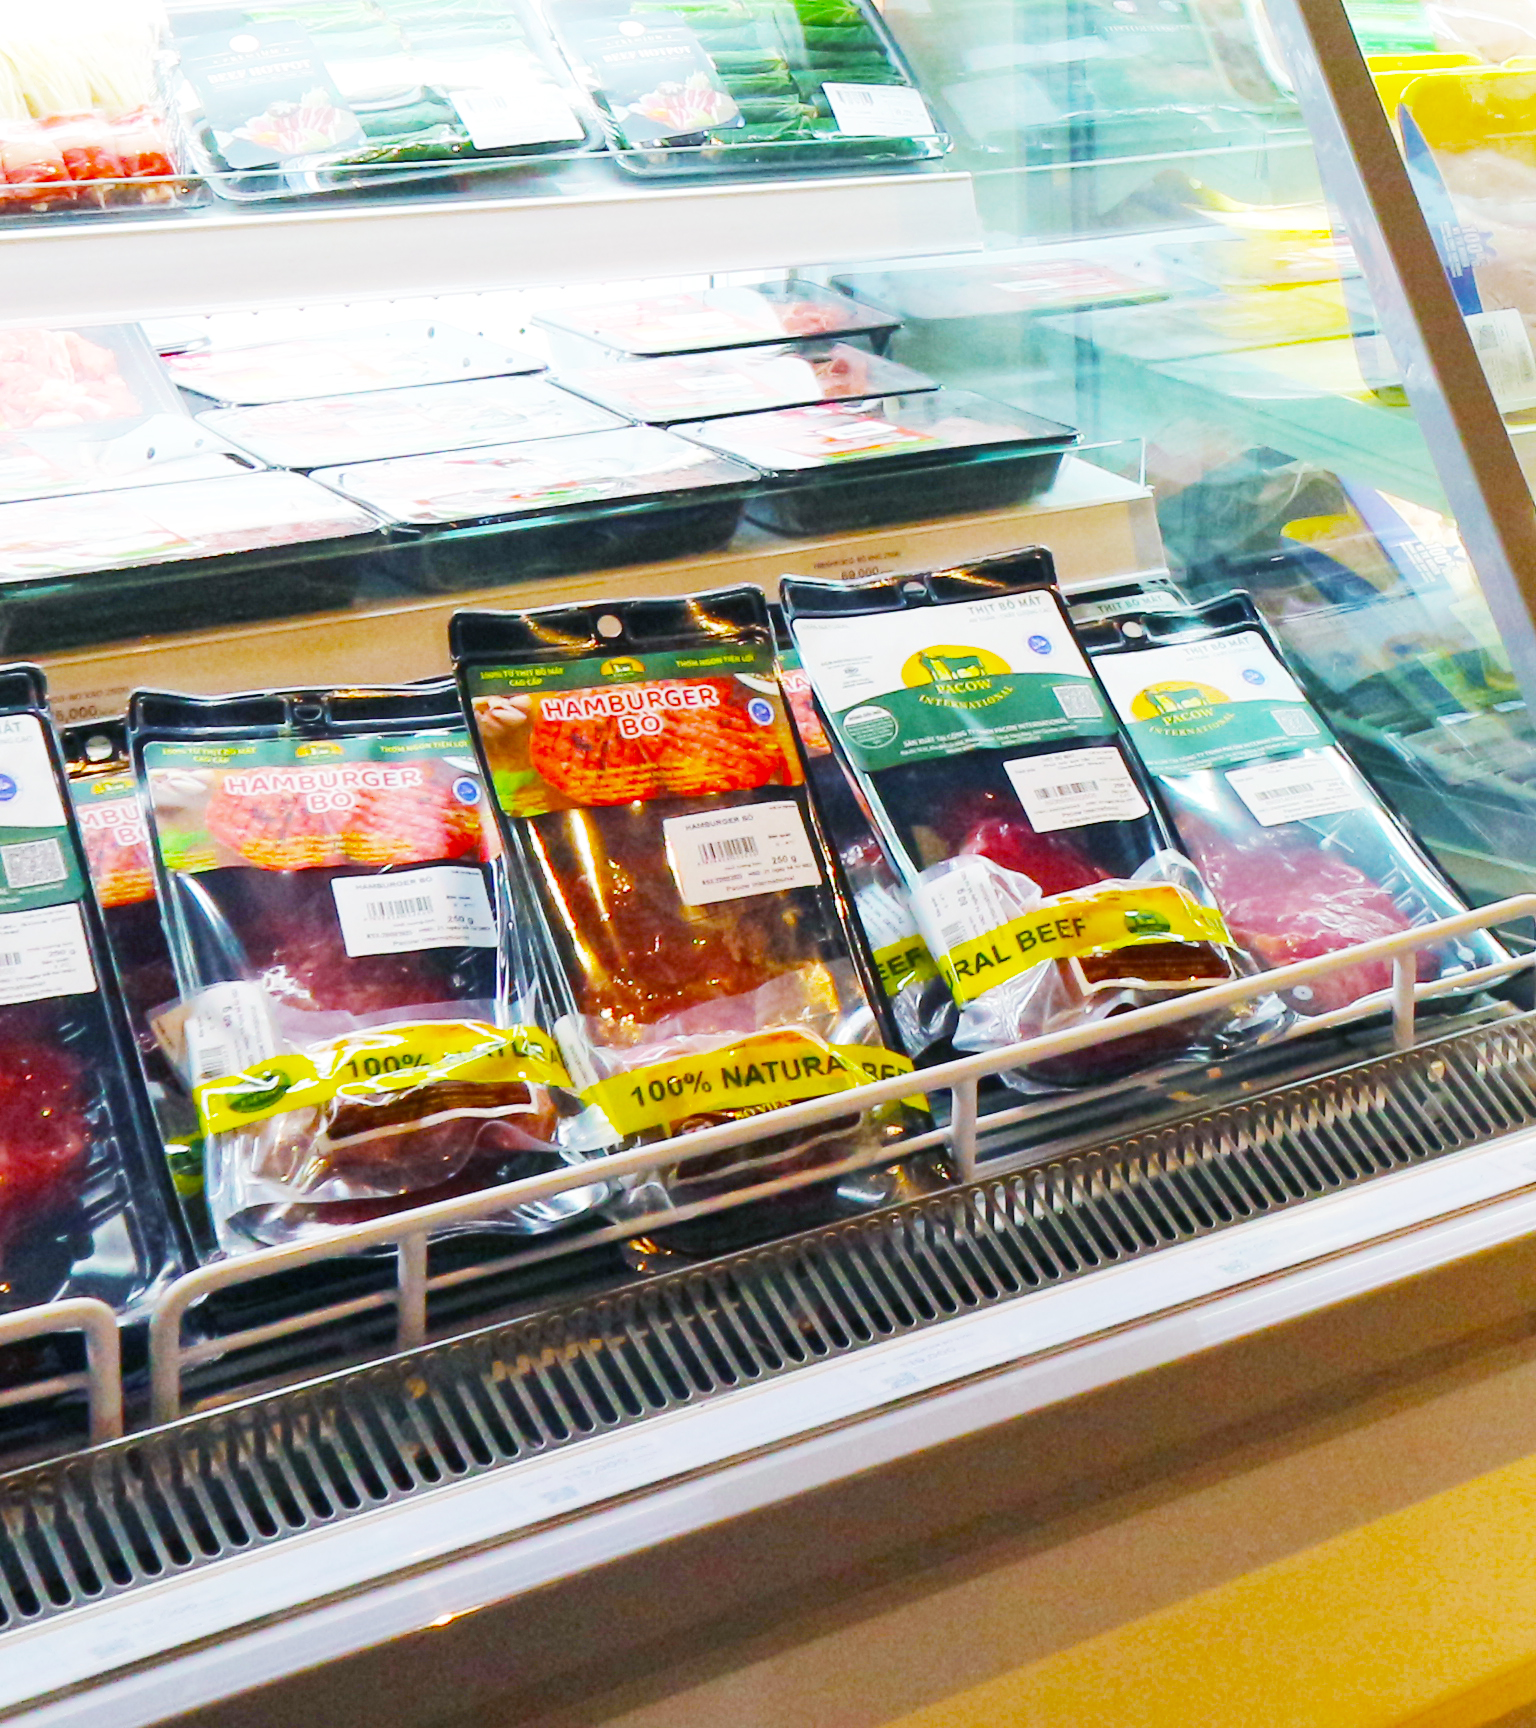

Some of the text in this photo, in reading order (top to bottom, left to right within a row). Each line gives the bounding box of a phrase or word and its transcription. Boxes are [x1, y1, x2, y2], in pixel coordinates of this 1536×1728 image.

[602, 45, 691, 63] BEEF HOTPOT
[998, 599, 1016, 612] BÒ
[1018, 593, 1042, 609] MÁT
[918, 685, 1015, 710] INTERNATIONAL
[935, 678, 993, 695] PACOW
[541, 685, 720, 721] HAMBURGER
[619, 712, 664, 739] BÒ
[1148, 712, 1237, 737] INTERNATIONAL
[1161, 708, 1214, 727] PACOW
[224, 767, 423, 796] HAMBURGER
[306, 787, 355, 814] BÒ
[685, 813, 755, 832] HAMBURGER BÒ
[771, 855, 788, 865] 250
[355, 877, 417, 891] HAMBURGER
[447, 915, 465, 925] 250
[1016, 915, 1089, 952] BEEF
[344, 1052, 431, 1080] 100%
[630, 1054, 850, 1109] 100% NATURA
